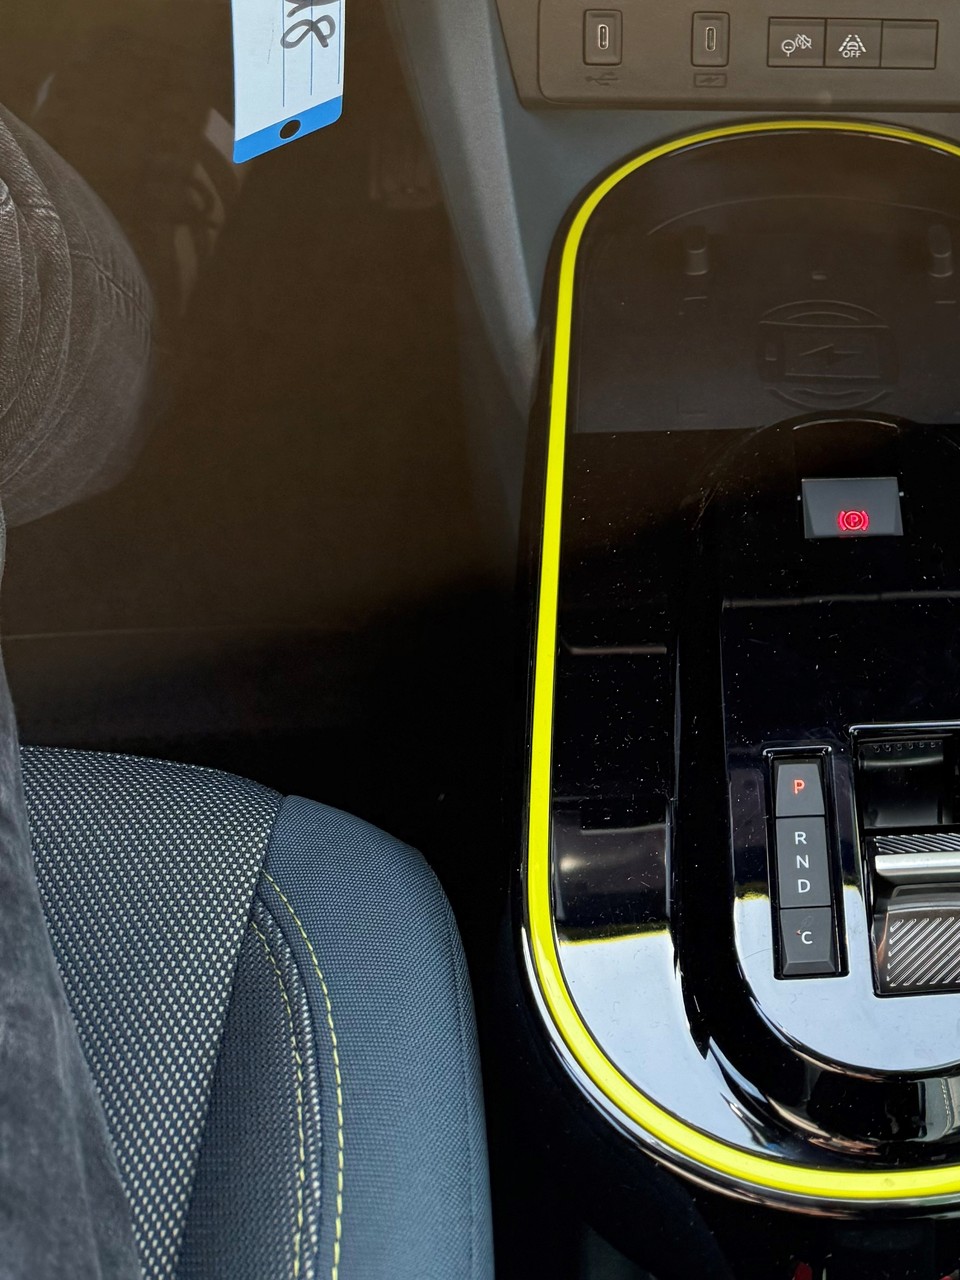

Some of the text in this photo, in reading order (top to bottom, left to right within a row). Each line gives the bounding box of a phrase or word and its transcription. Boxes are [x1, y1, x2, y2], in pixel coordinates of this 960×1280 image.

[842, 49, 862, 59] OFF
[793, 779, 806, 795] P
[794, 831, 808, 845] R
[796, 854, 810, 869] N
[797, 878, 811, 894] D
[801, 930, 813, 945] C
